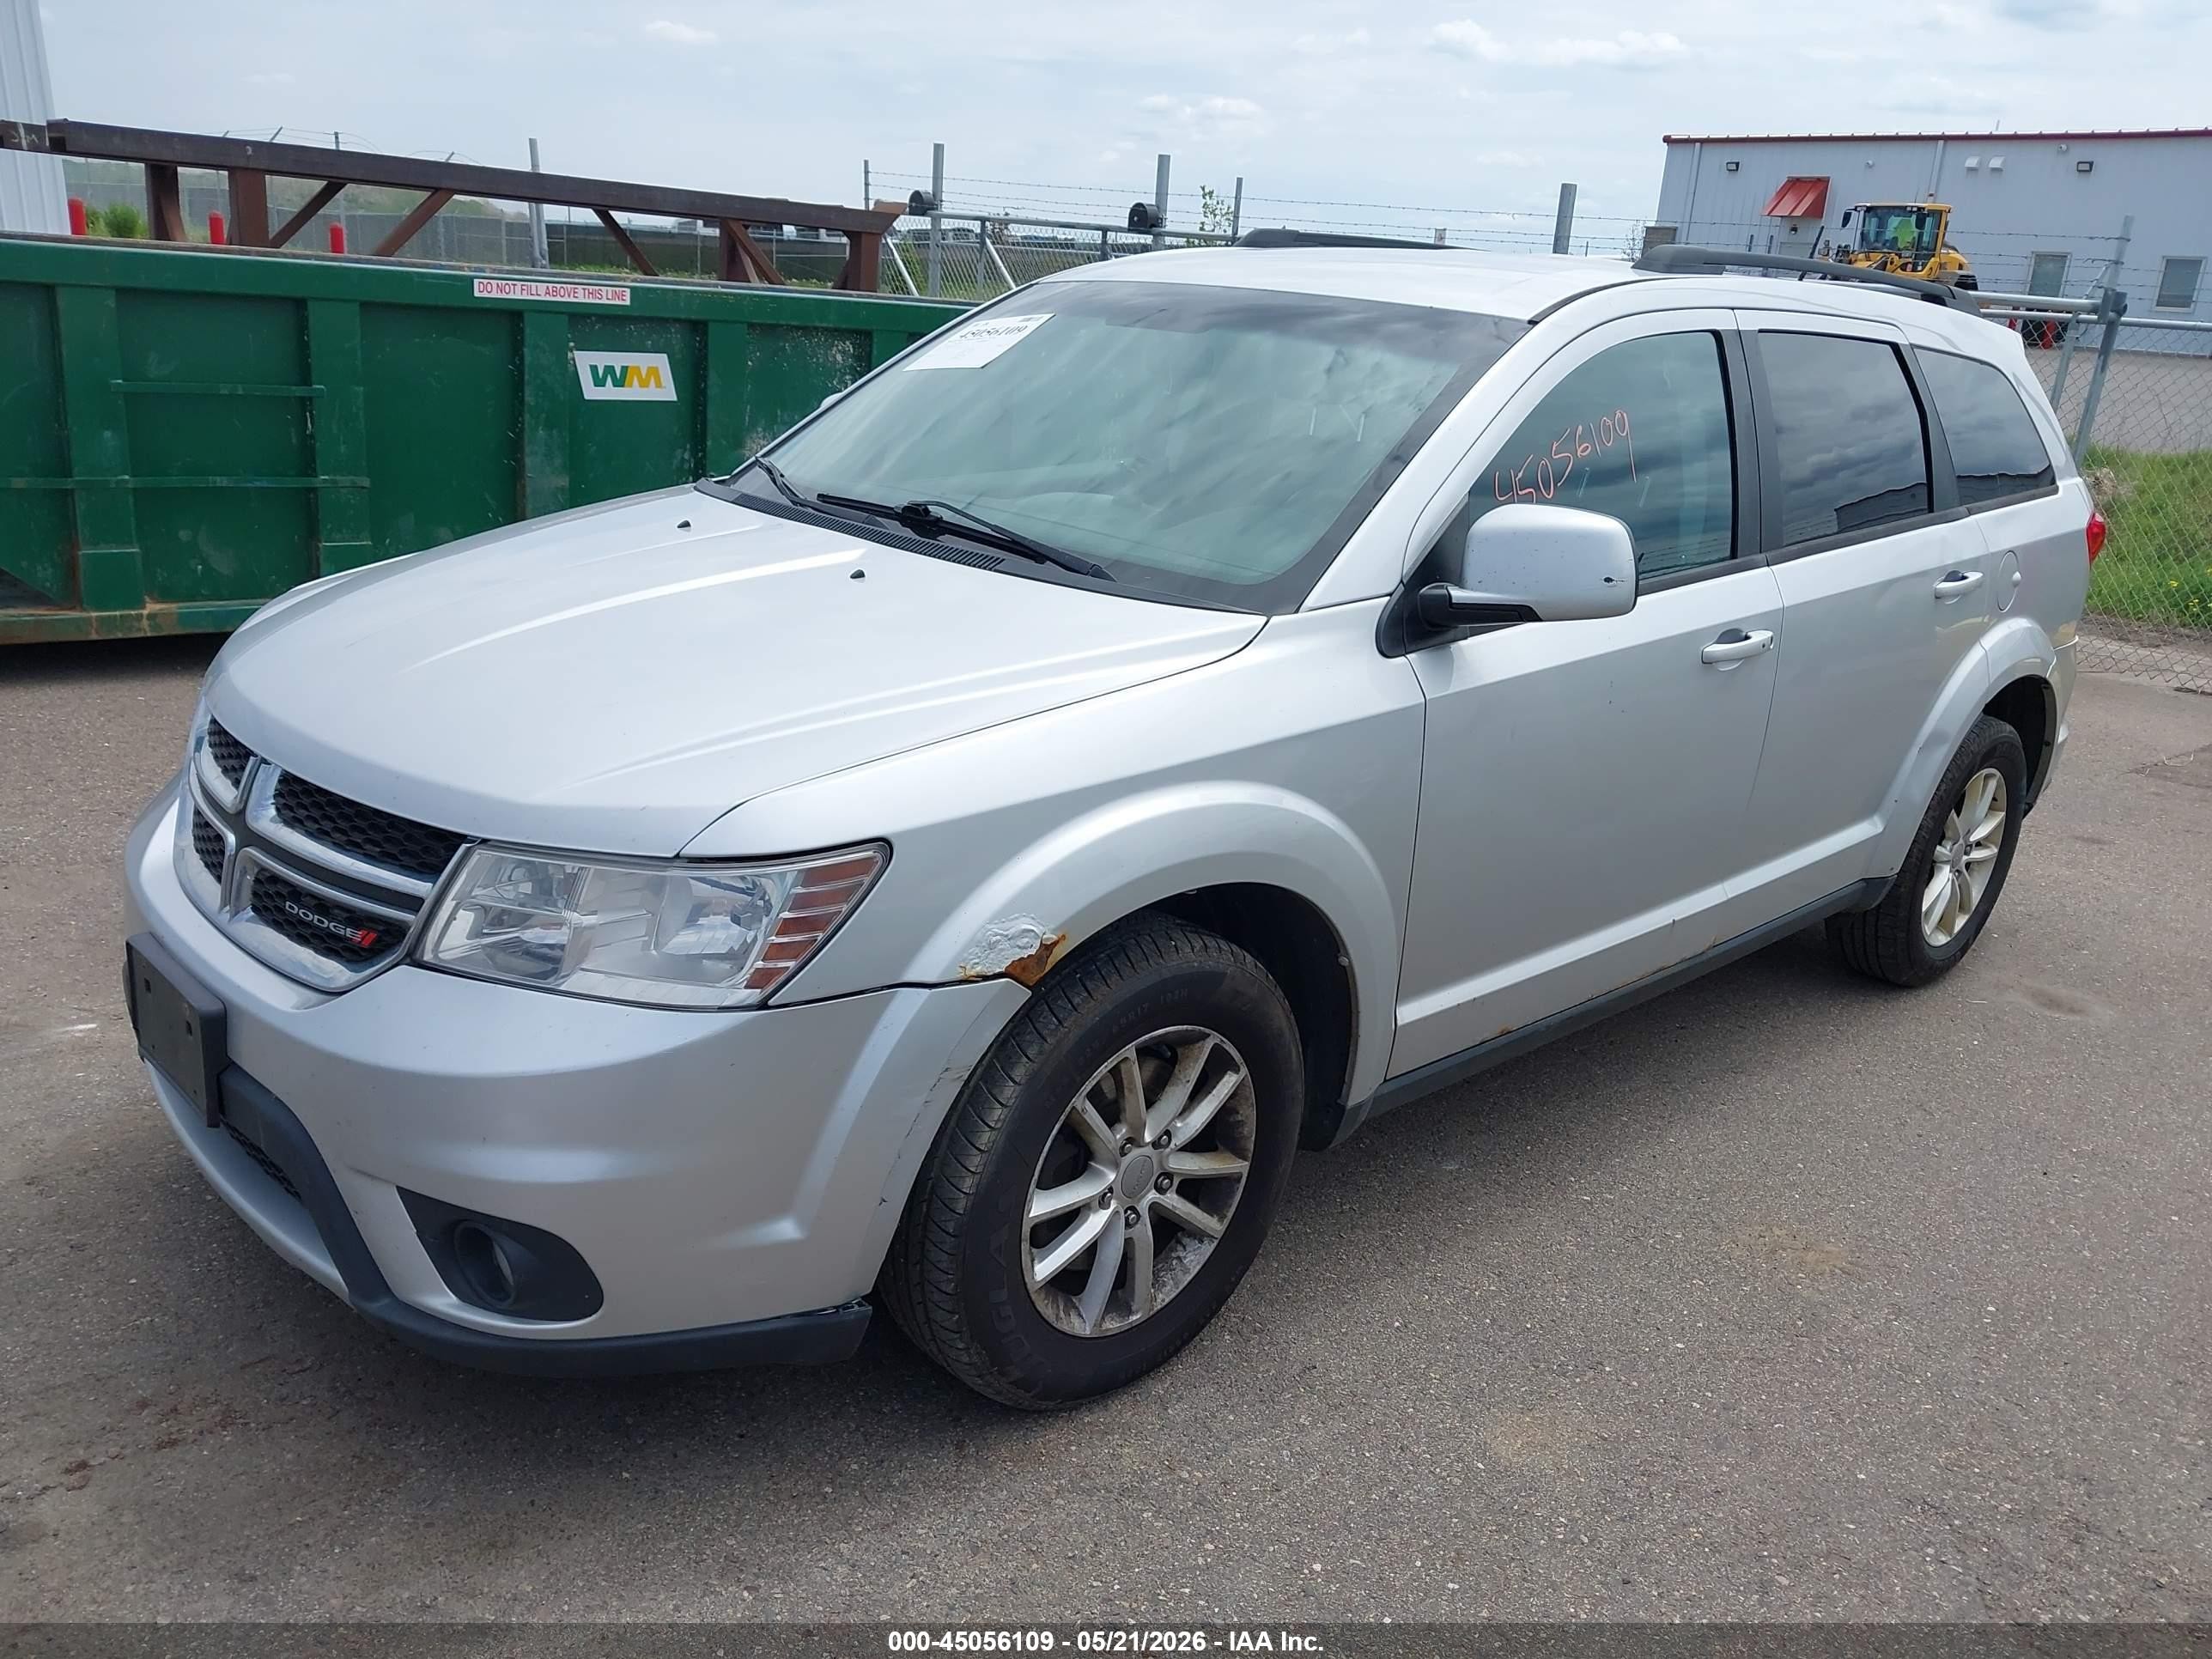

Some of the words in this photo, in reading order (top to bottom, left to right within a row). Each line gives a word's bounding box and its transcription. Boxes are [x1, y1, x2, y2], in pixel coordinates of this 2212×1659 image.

[477, 281, 493, 294] DO
[496, 282, 518, 295] NOT
[520, 283, 541, 296] FILL
[544, 285, 579, 299] ABOVE
[582, 288, 603, 300] THIS
[605, 289, 627, 301] LINE
[588, 364, 664, 389] WM
[1494, 409, 1637, 504] 45056109
[285, 901, 363, 942] DODGE
